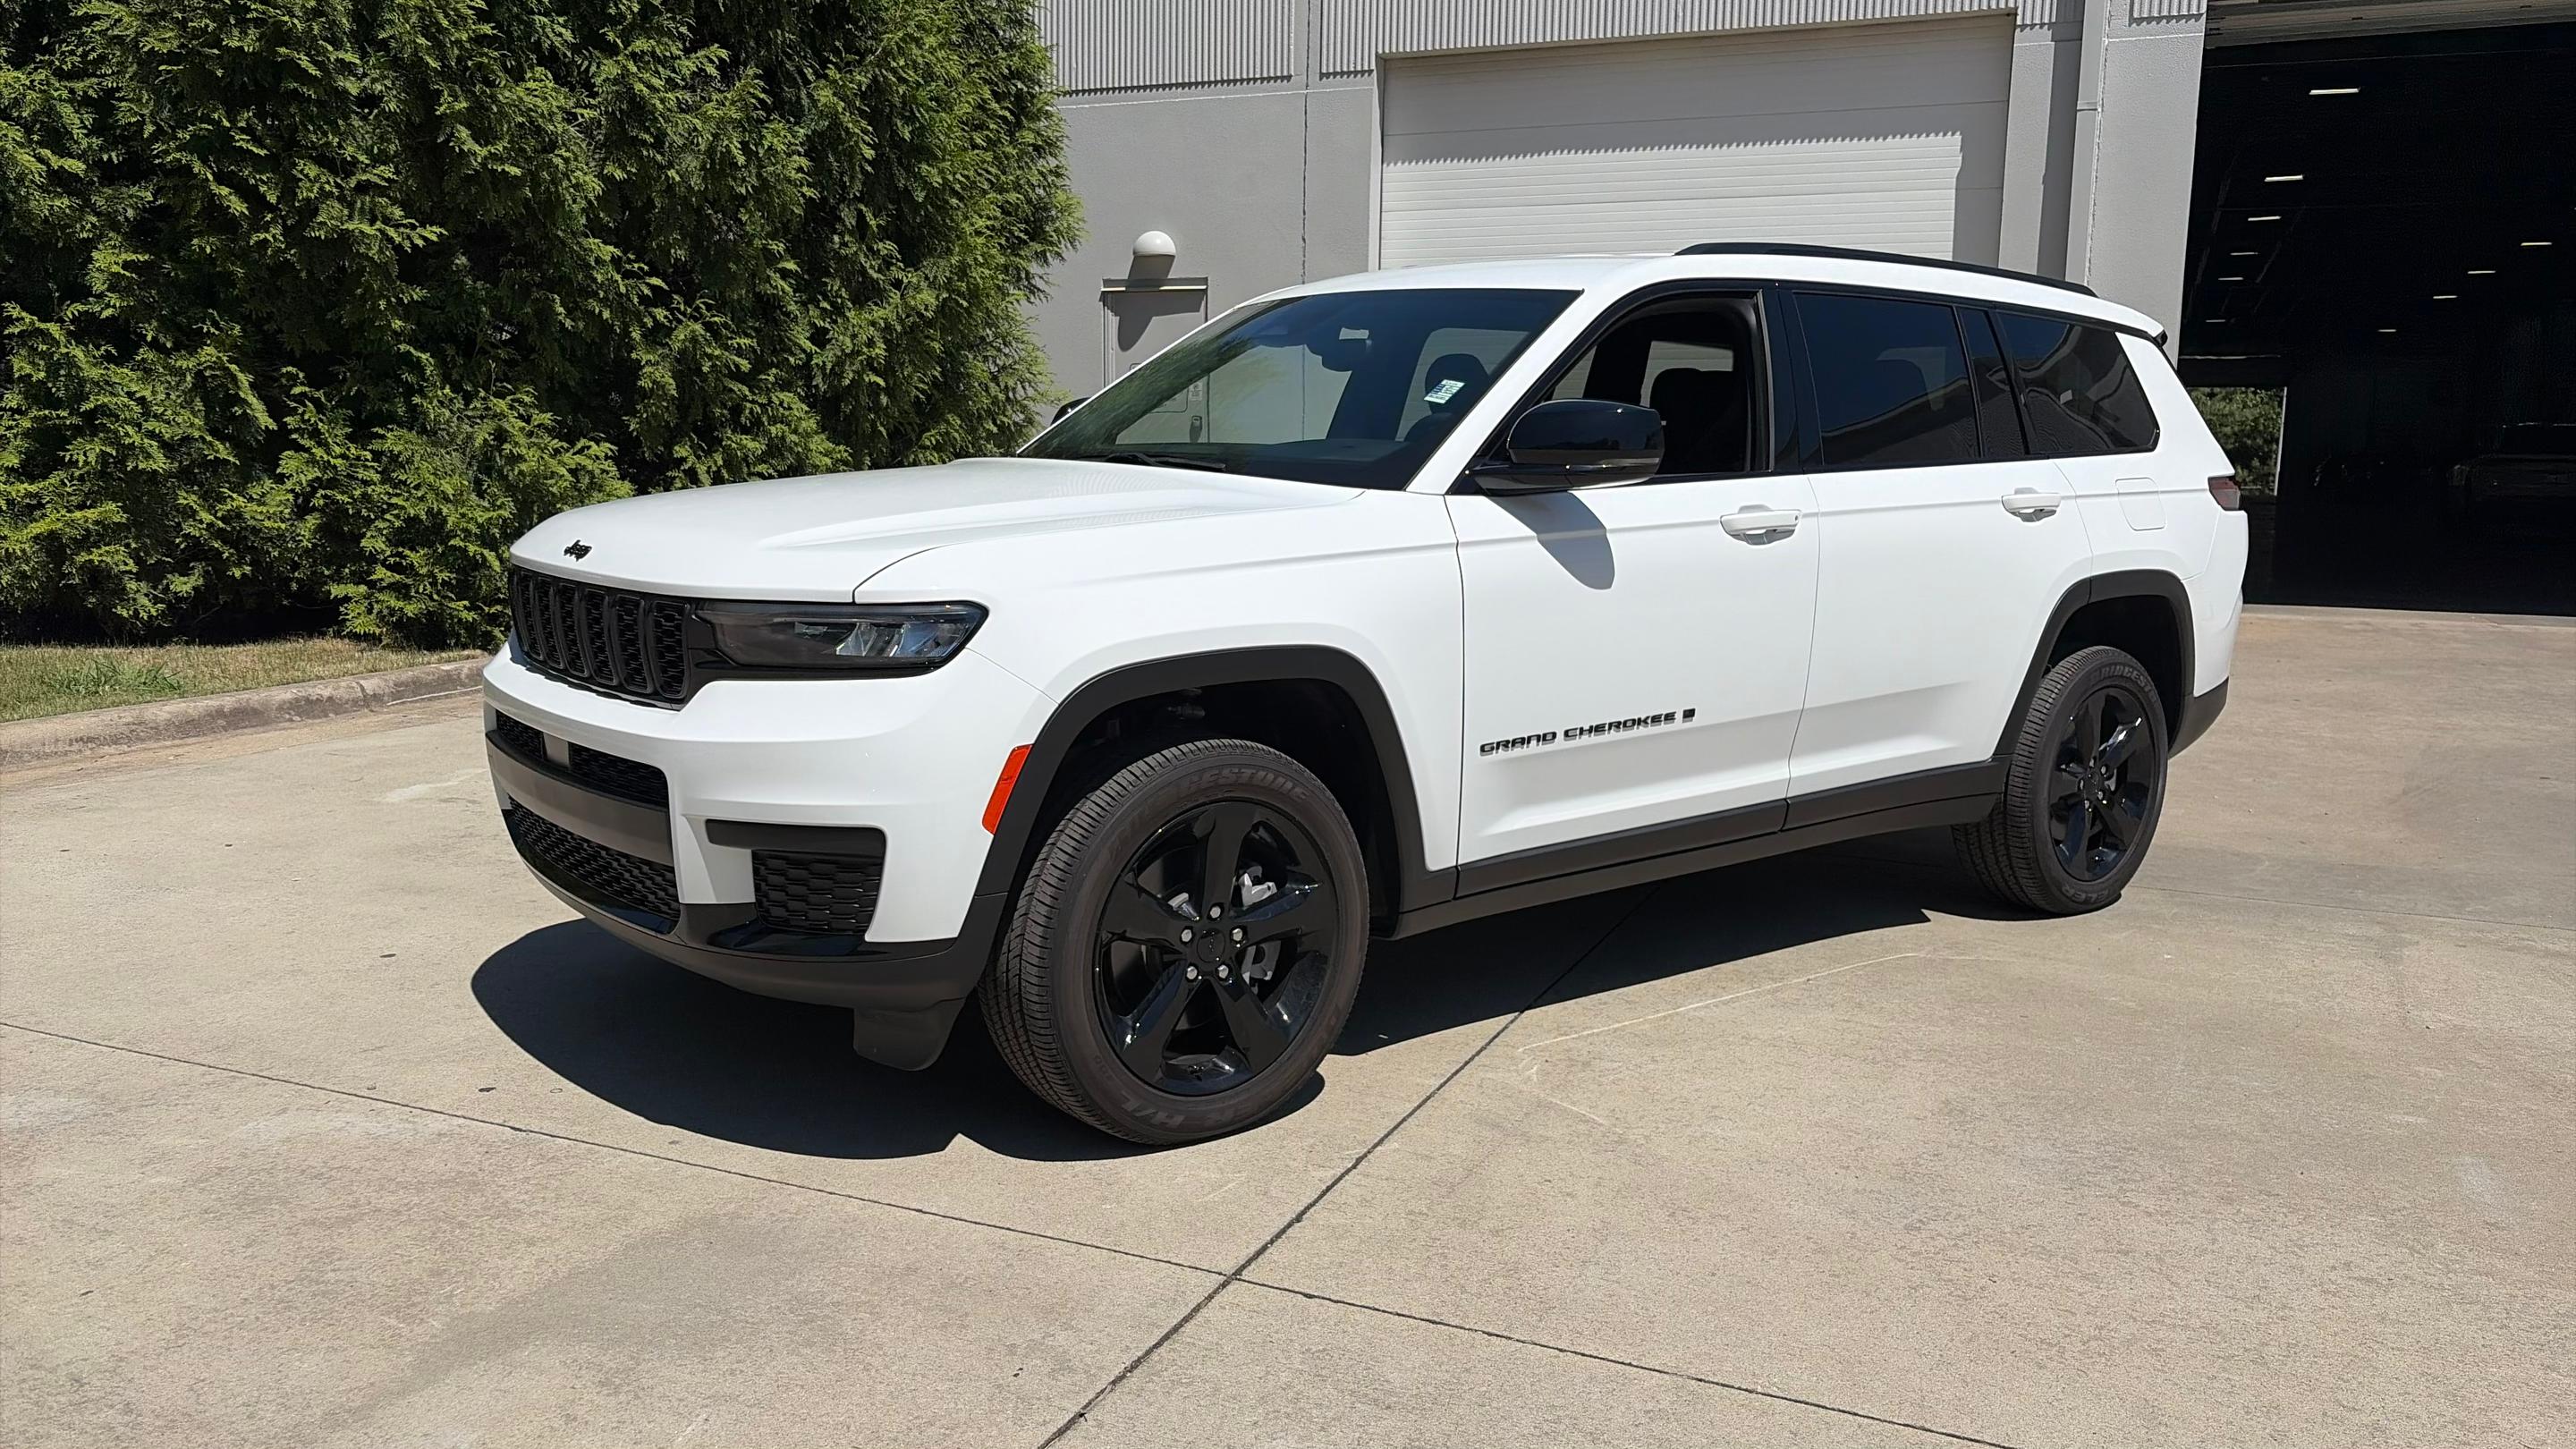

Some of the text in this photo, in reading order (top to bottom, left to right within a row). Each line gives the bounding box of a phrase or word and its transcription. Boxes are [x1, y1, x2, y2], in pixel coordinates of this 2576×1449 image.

[564, 539, 592, 562] Jeep
[1479, 731, 1557, 755] GRAND
[1563, 711, 1677, 740] CHEROKEE
